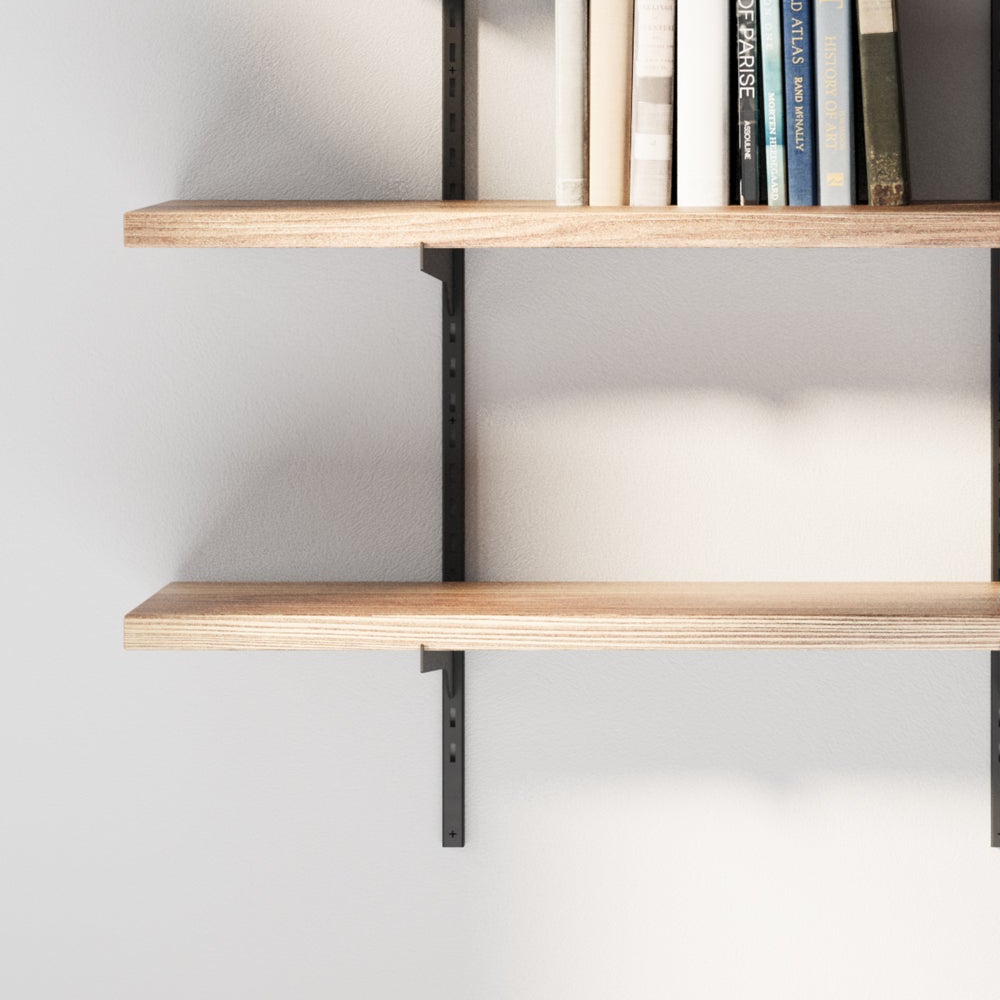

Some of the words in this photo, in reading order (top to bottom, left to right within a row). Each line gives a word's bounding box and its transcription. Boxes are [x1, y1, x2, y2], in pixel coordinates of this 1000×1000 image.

[791, 17, 805, 64] ATLAS
[738, 26, 756, 99] PARISE
[823, 36, 837, 97] HISTORY
[794, 77, 804, 103] RAND
[824, 99, 837, 120] OF
[767, 92, 777, 134] MORTEN
[743, 120, 751, 160] ASSOULINE
[825, 122, 837, 151] ART
